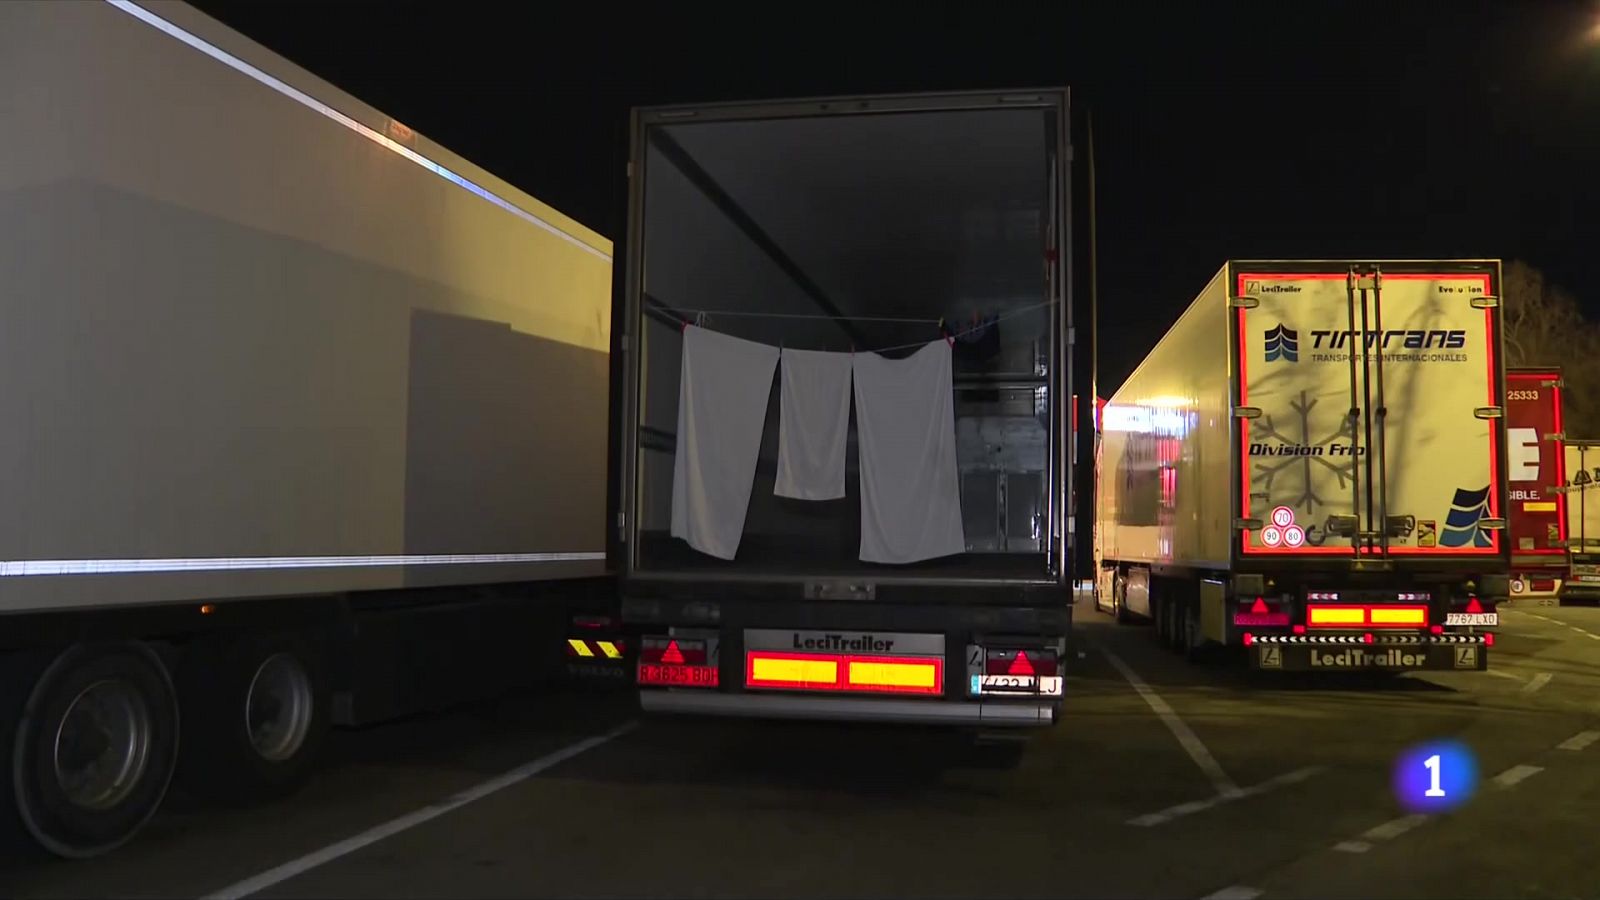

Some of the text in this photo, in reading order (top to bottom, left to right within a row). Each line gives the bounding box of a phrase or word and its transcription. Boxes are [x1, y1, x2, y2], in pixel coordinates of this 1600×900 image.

[1249, 443, 1324, 456] Division
[1277, 513, 1289, 523] 70
[1266, 531, 1277, 541] 90
[1288, 531, 1299, 541] 80
[1448, 614, 1473, 624] 7767
[793, 633, 894, 651] LeciTrailer
[1311, 649, 1426, 666] LeciTrailer
